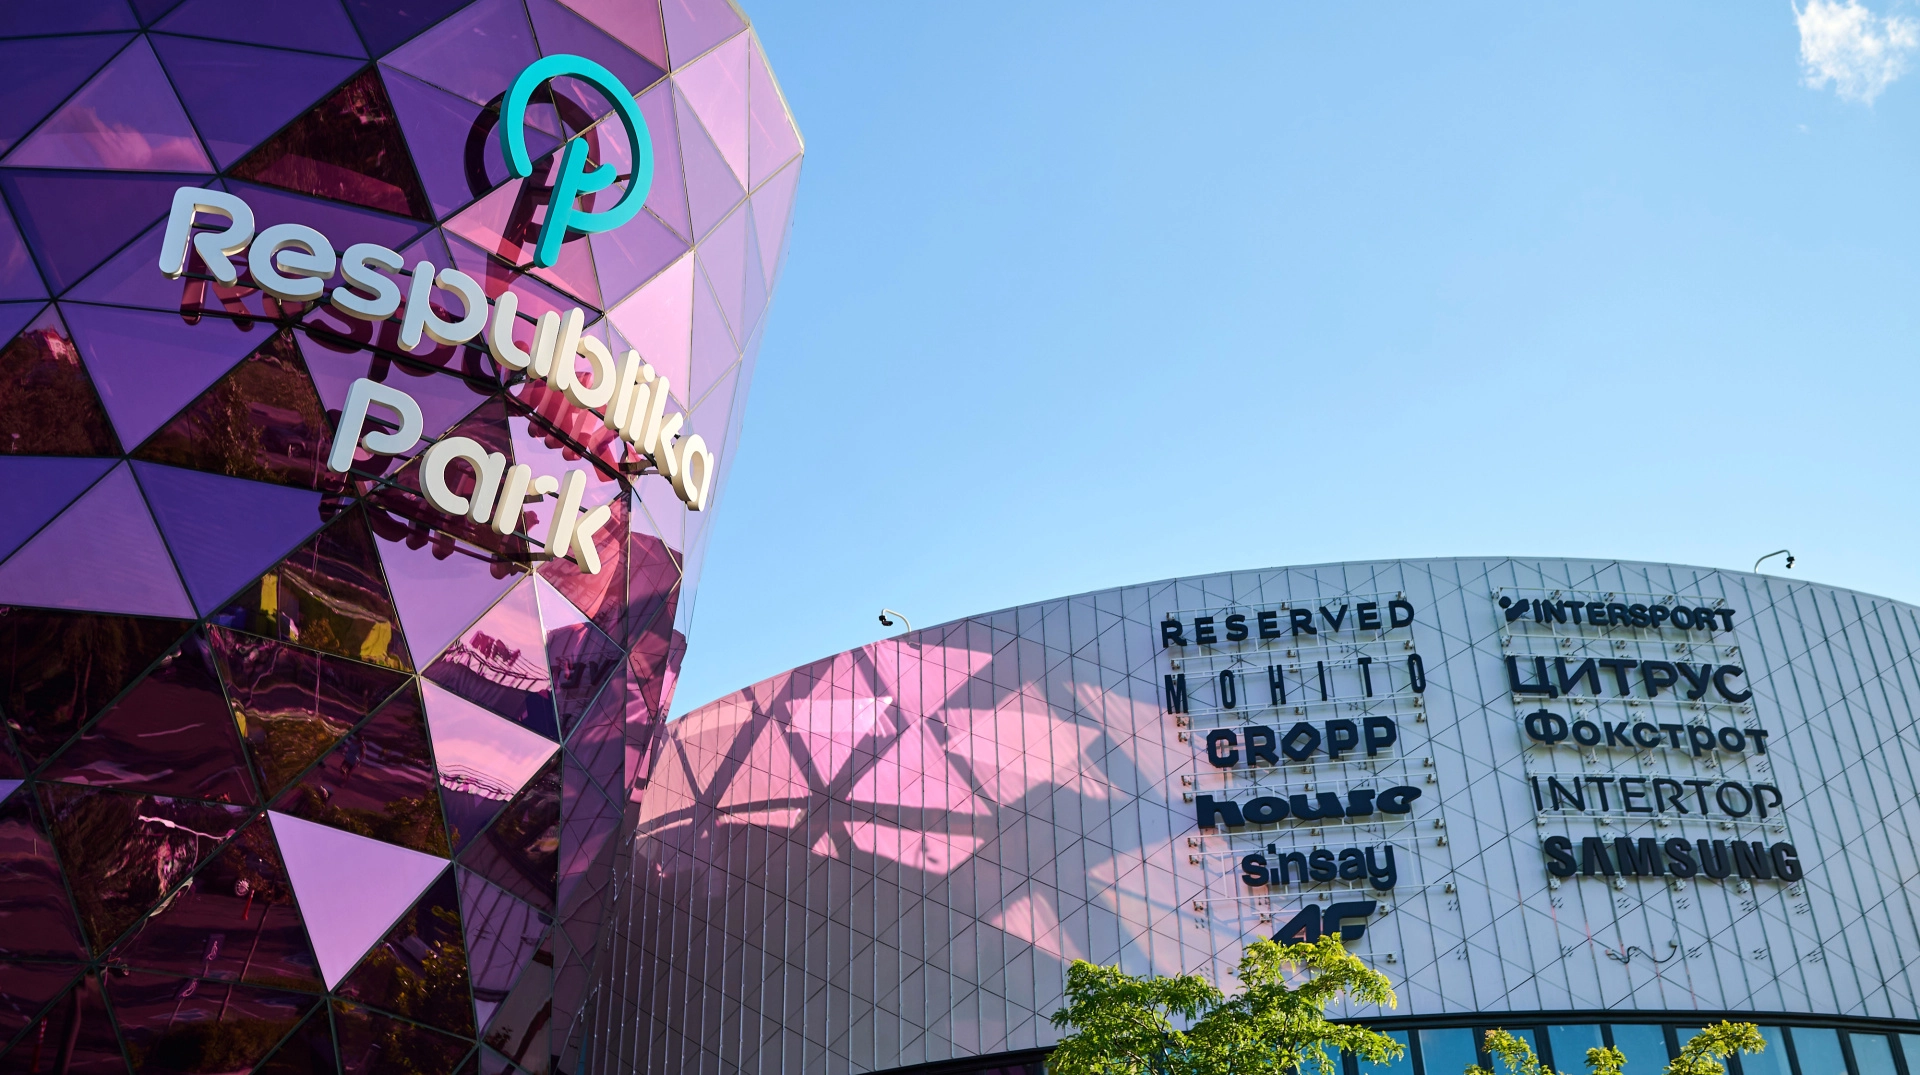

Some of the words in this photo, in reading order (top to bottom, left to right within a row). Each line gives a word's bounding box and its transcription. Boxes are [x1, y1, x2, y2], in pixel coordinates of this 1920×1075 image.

[159, 187, 715, 511] Respublika
[327, 378, 612, 574] Park
[1161, 600, 1415, 648] RESERVED
[1533, 599, 1735, 632] INTERSPORT
[1164, 653, 1426, 714] MOHITO
[1506, 655, 1753, 703] ЦИТРУС
[1206, 715, 1397, 768] CROPP
[1524, 709, 1769, 756] Фокстрот
[1195, 785, 1422, 828] house
[1532, 776, 1783, 819] INTERTOP
[1241, 843, 1397, 890] sinsay
[1543, 836, 1802, 882] SAMSUNG
